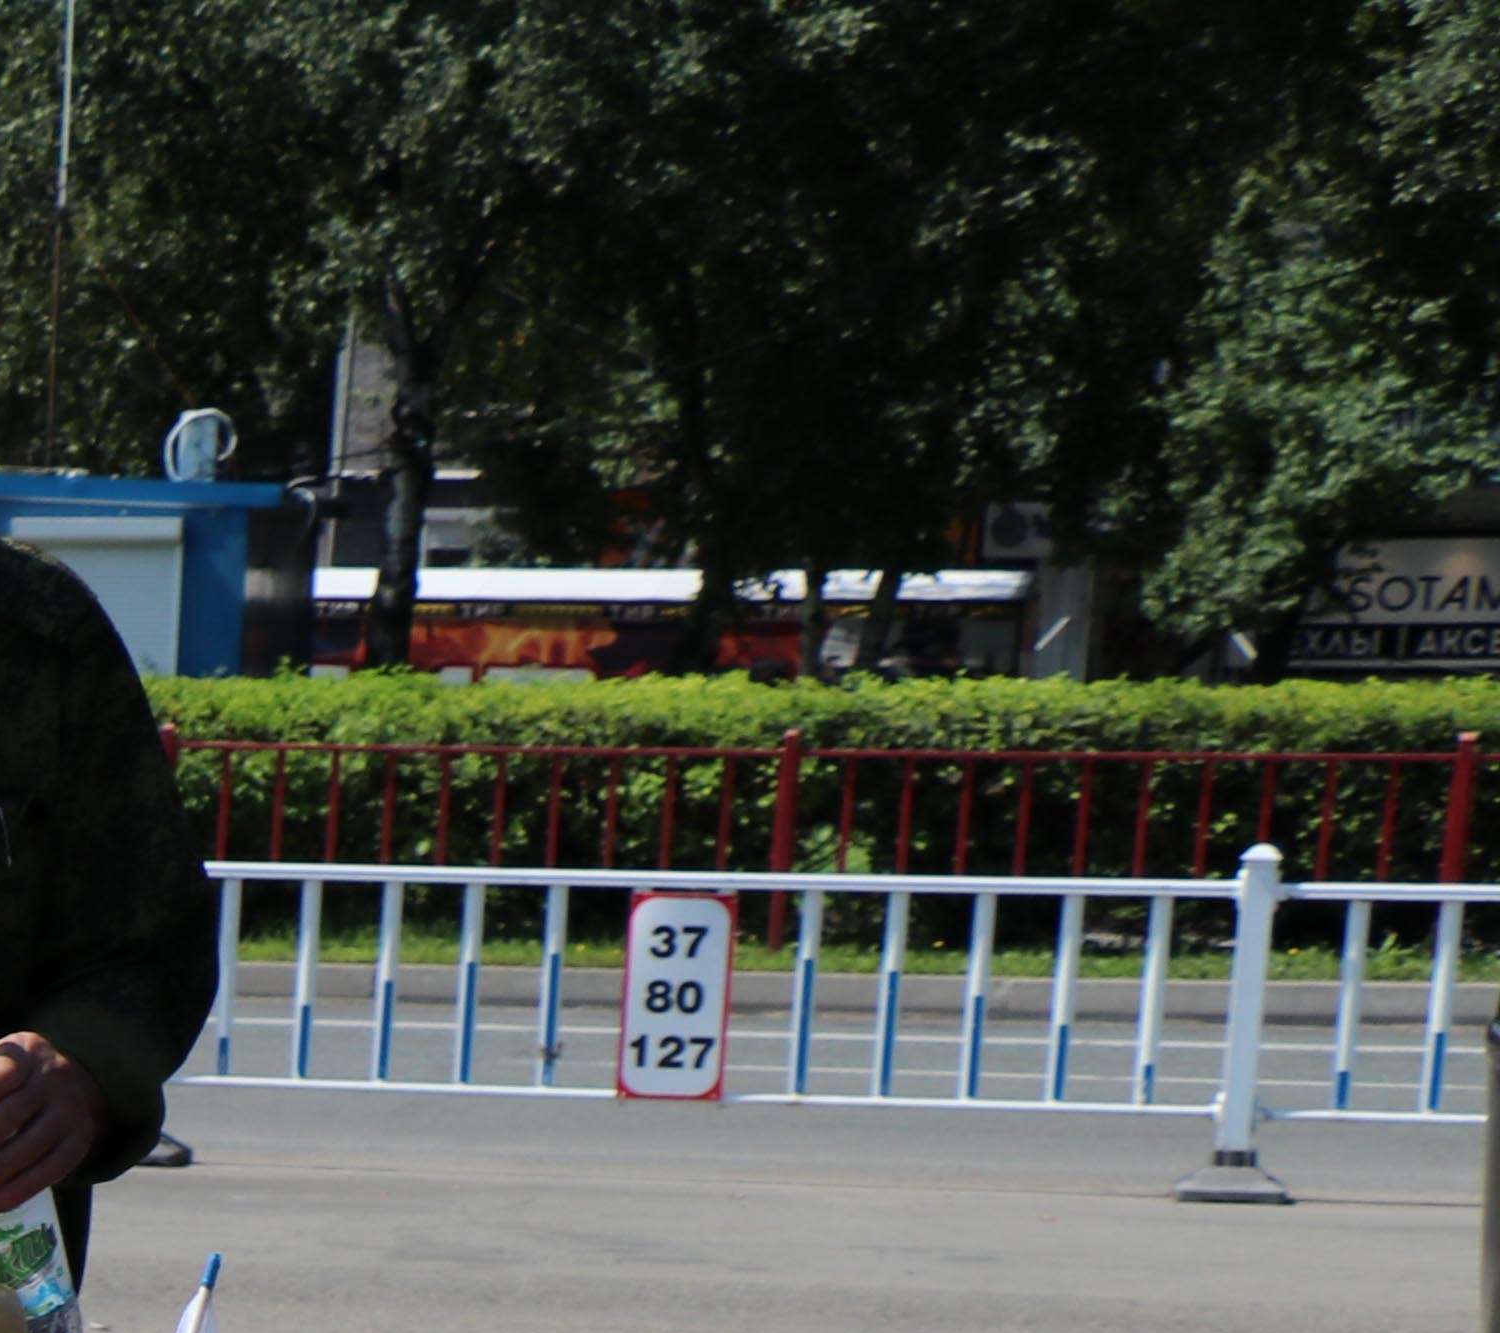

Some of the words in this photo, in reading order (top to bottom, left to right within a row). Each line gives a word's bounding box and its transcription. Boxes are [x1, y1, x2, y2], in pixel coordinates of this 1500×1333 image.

[650, 925, 709, 959] 37
[645, 980, 704, 1014] 80
[629, 1034, 716, 1070] 127
